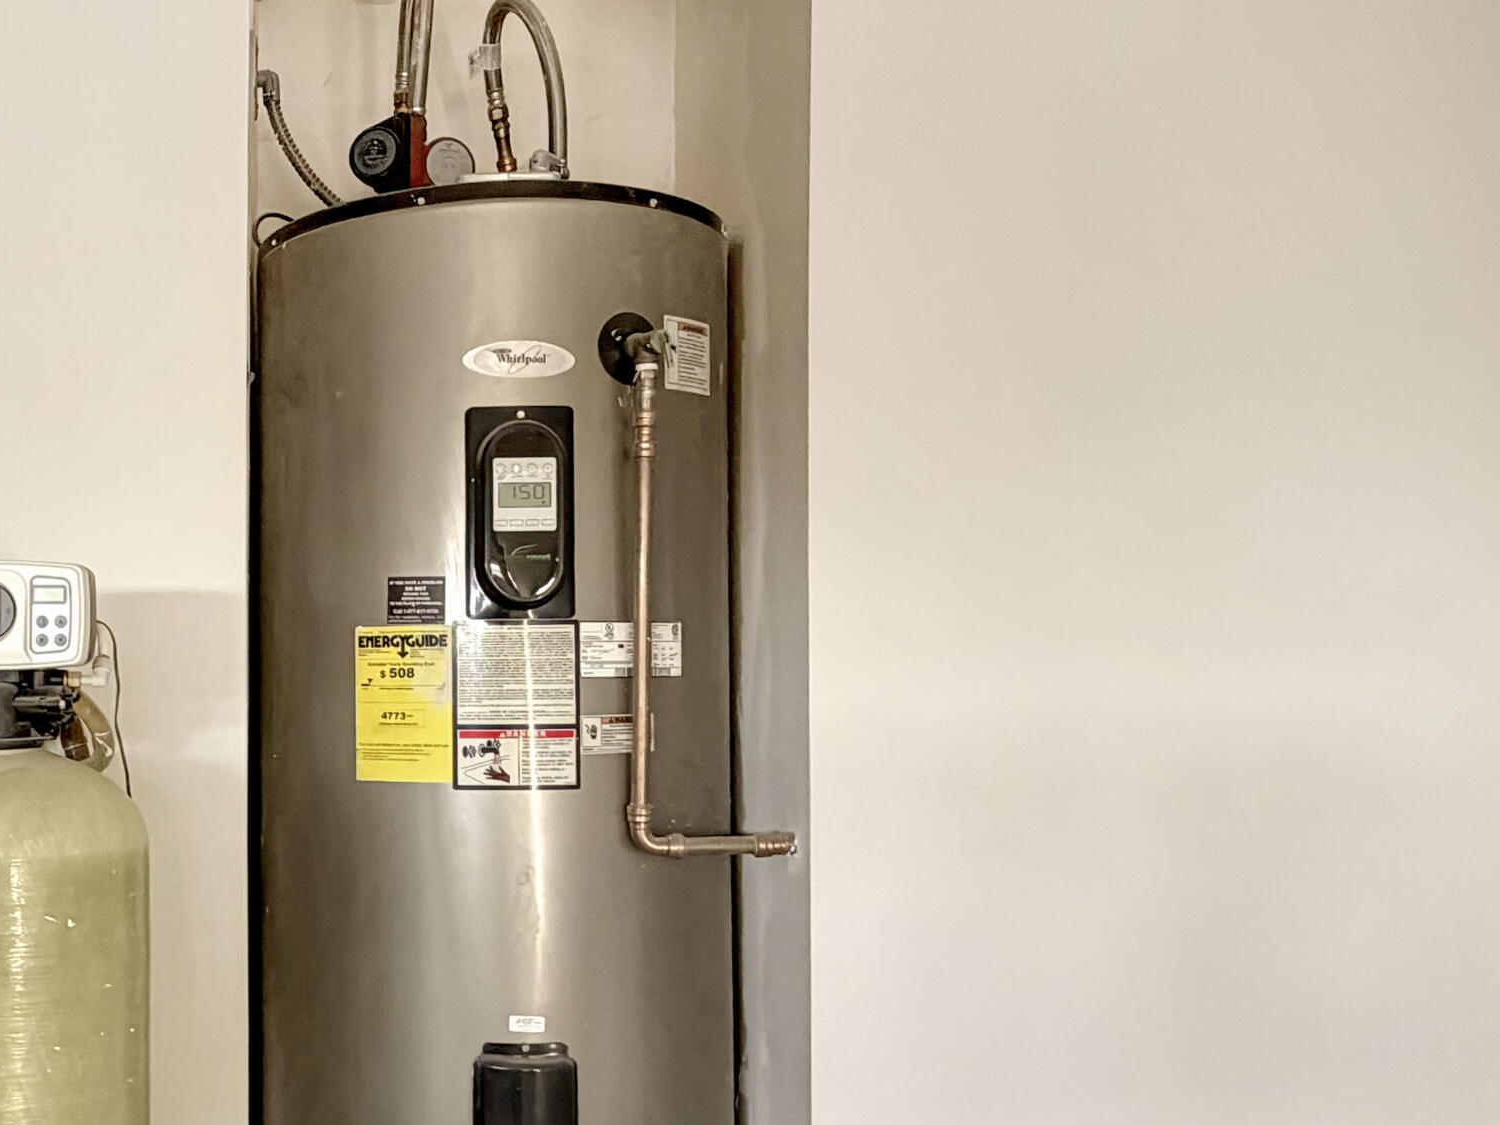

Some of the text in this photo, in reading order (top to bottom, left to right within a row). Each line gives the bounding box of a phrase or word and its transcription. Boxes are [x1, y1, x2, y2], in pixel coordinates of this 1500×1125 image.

[496, 353, 547, 366] Whirlpool
[511, 484, 546, 500] 150
[389, 668, 415, 678] 508
[380, 711, 406, 721] 4773
[506, 730, 546, 738] DANER
